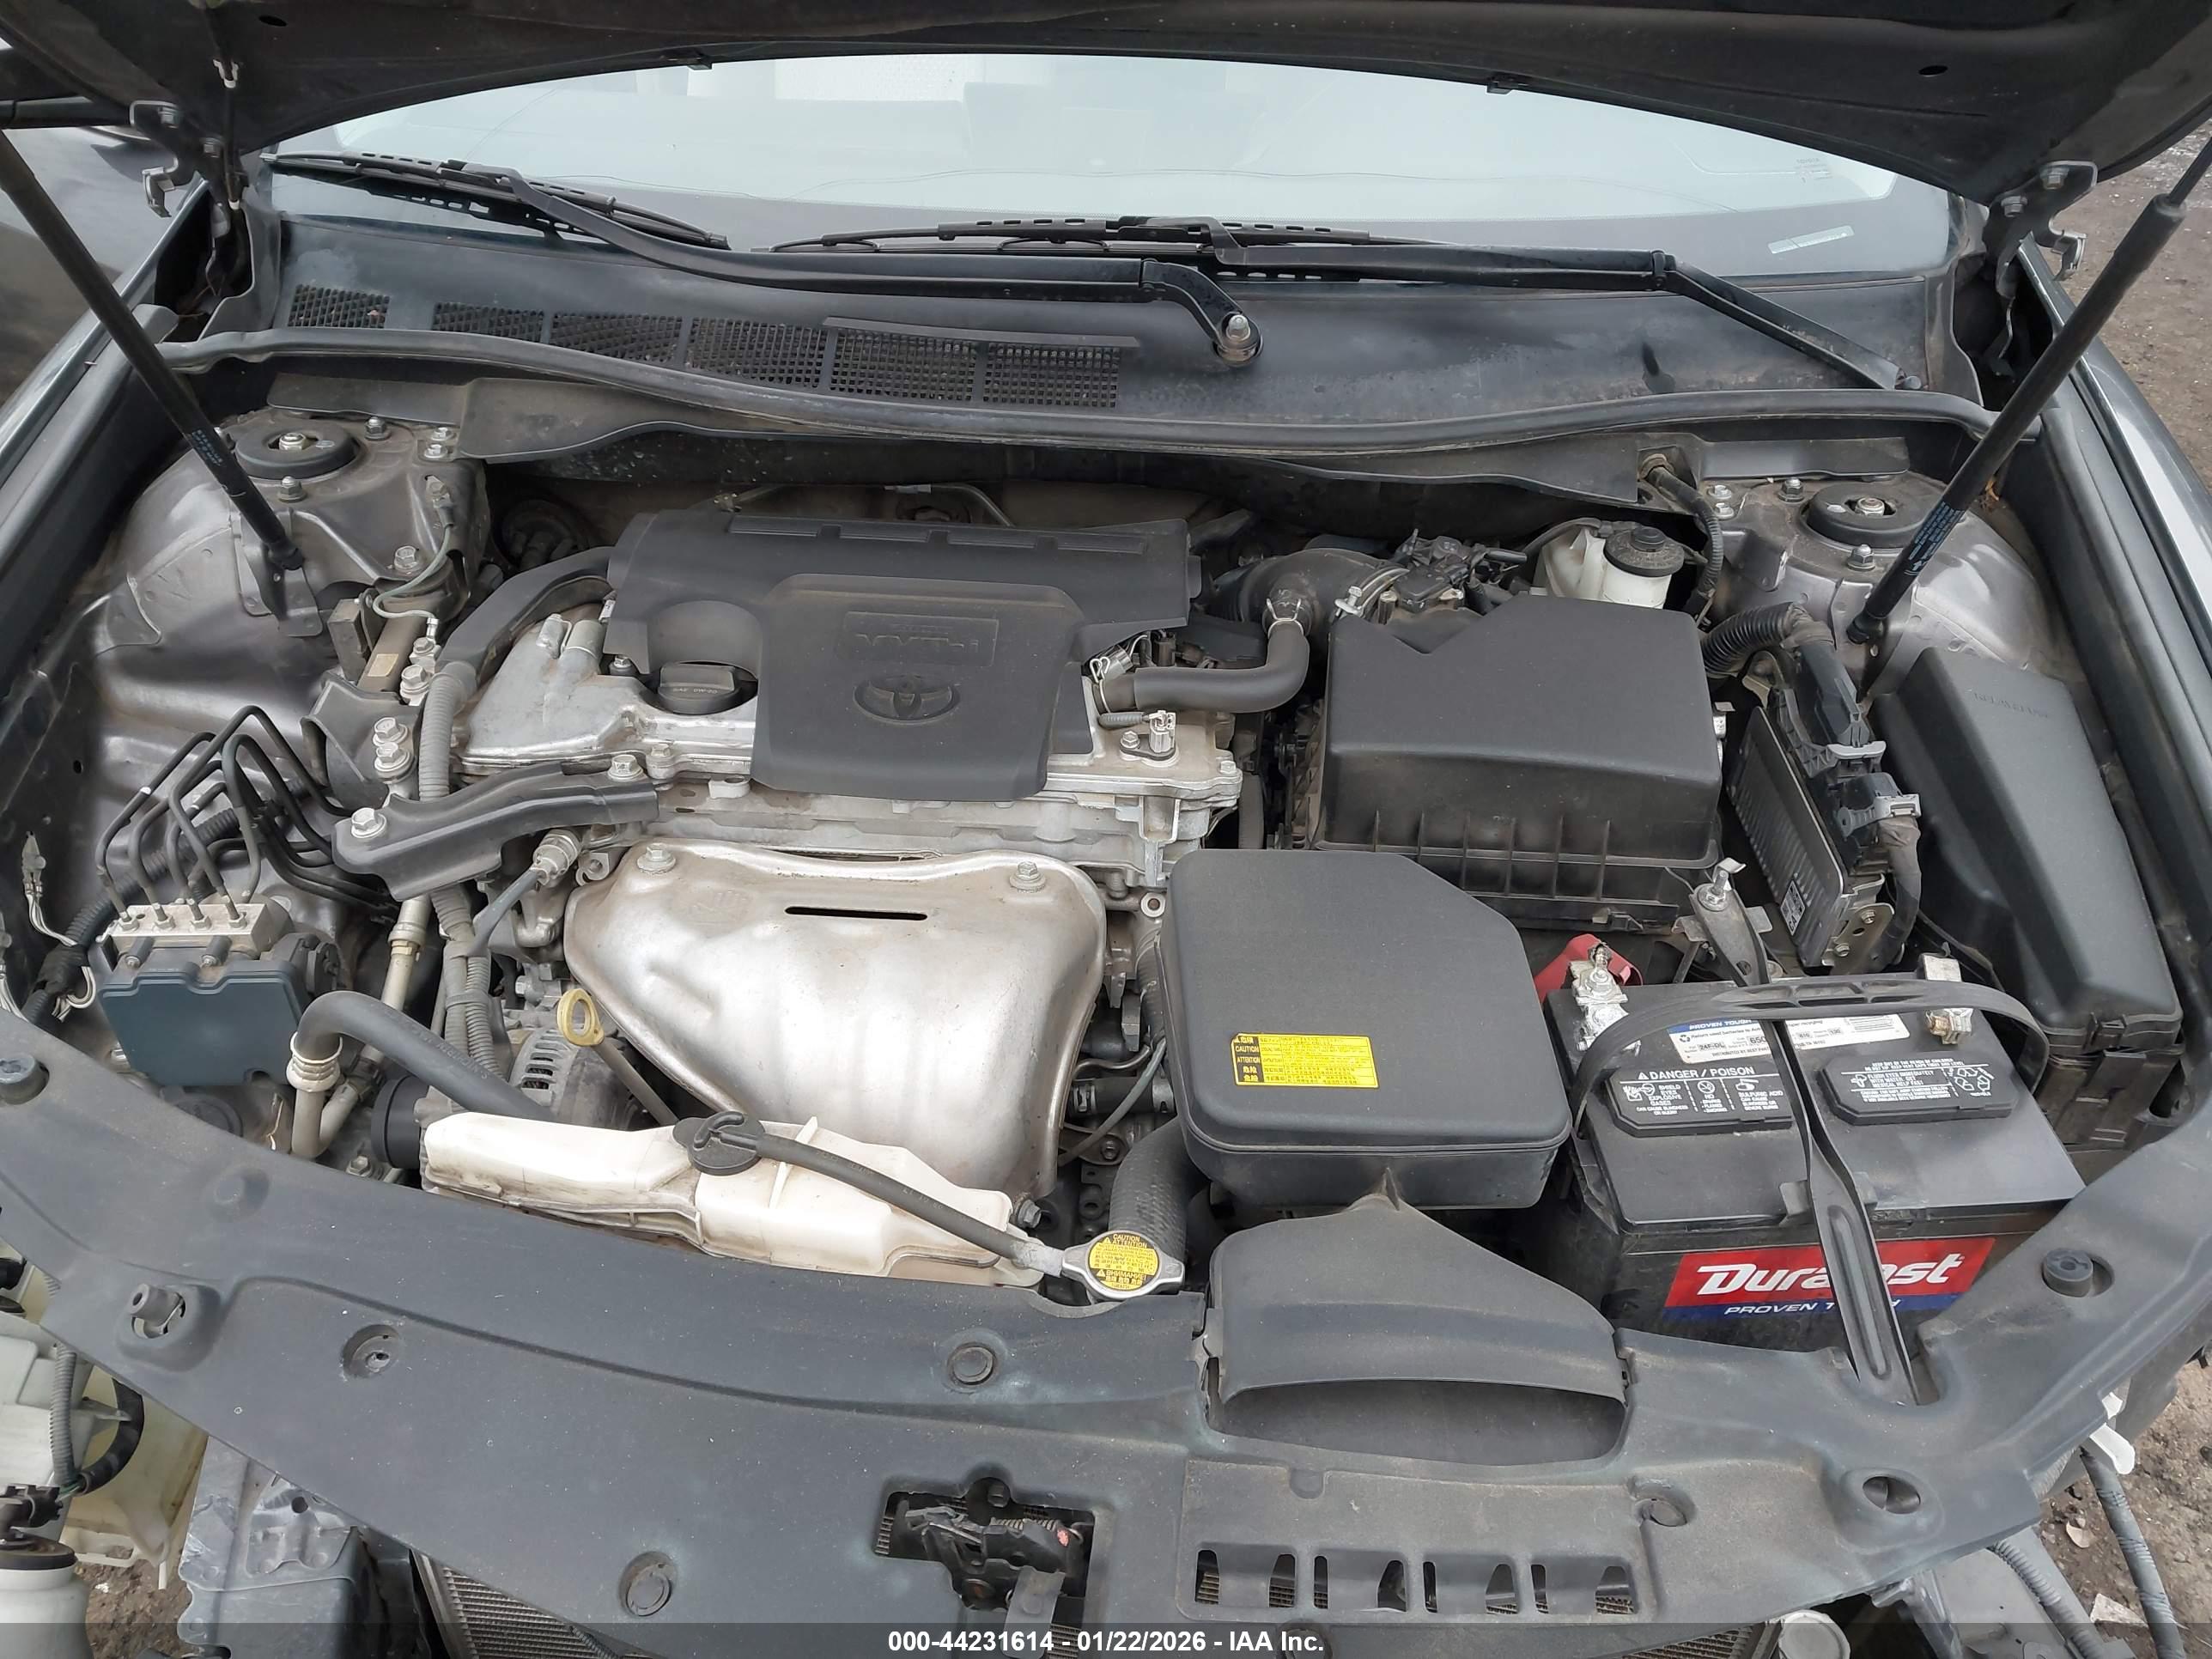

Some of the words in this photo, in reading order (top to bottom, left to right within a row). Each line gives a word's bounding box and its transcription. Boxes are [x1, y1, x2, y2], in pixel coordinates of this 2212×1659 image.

[1690, 1022, 1722, 1030] PROVEN
[1649, 1069, 1698, 1080] DANGER
[1711, 1066, 1754, 1077] POISON
[1112, 1239, 1147, 1248] ATTENTION
[1724, 1302, 1819, 1315] PROVEN
